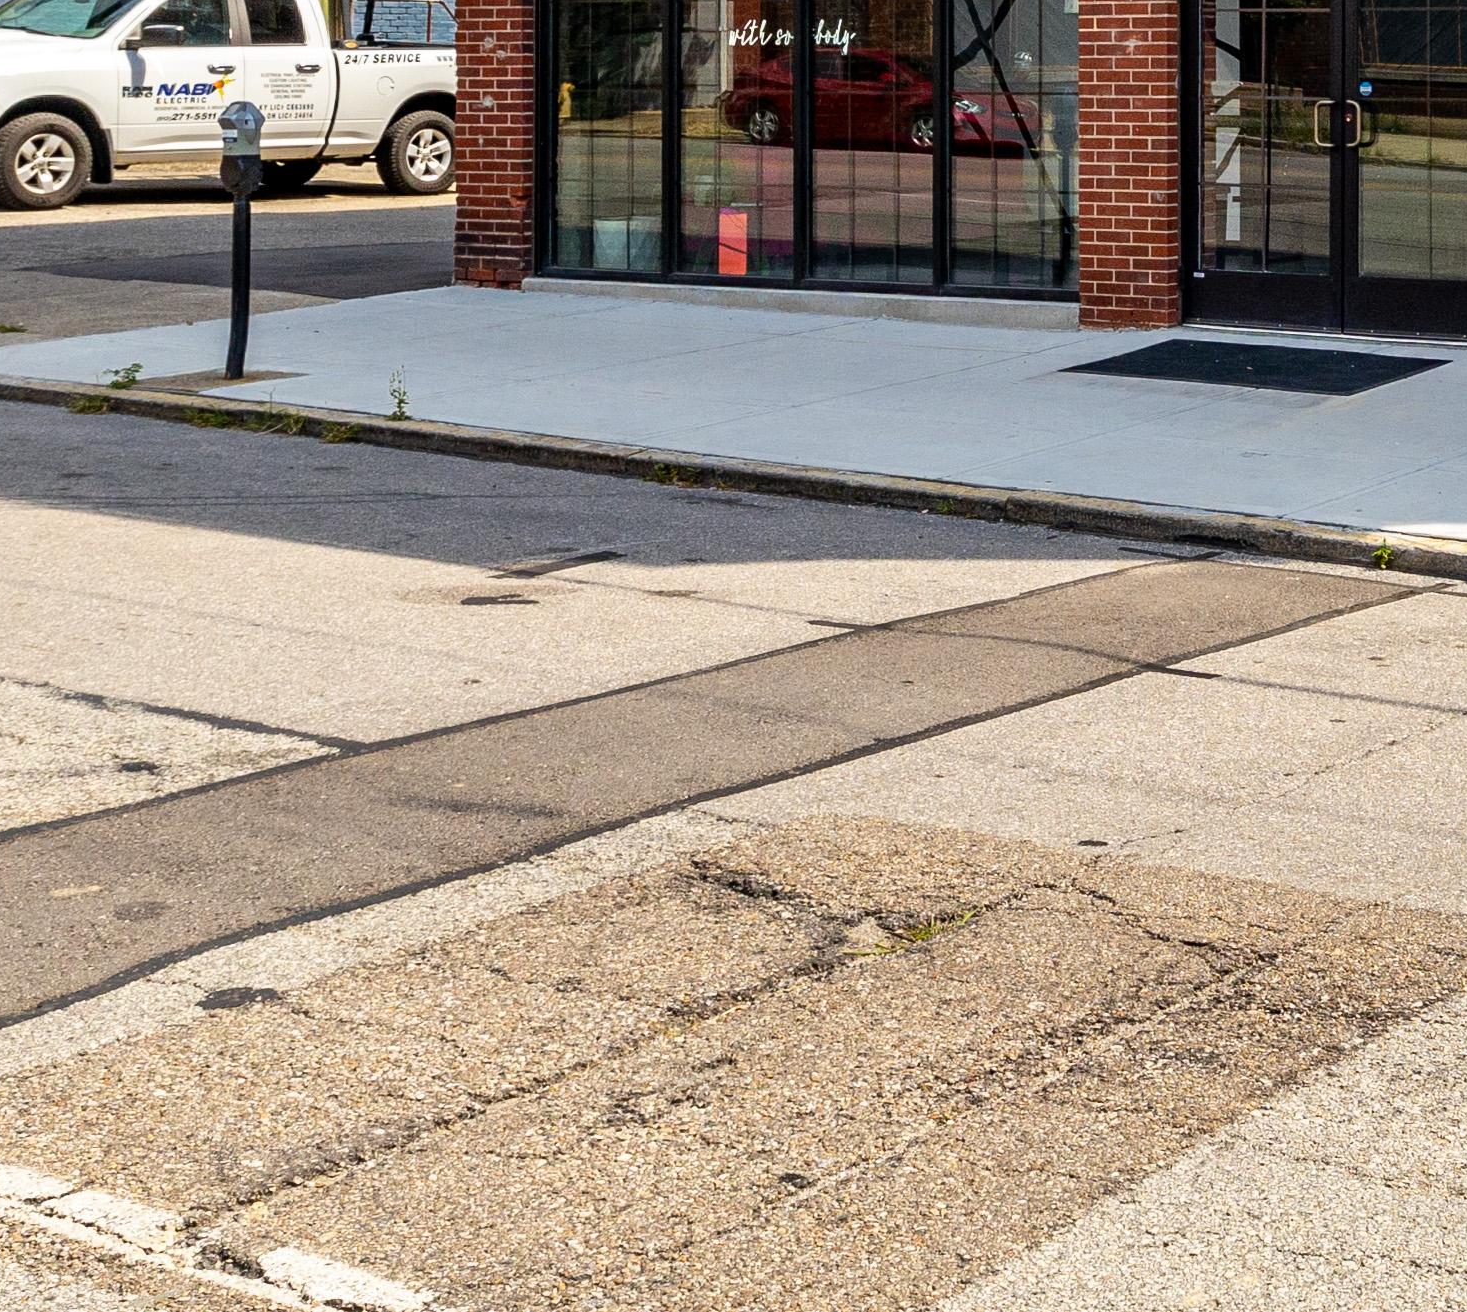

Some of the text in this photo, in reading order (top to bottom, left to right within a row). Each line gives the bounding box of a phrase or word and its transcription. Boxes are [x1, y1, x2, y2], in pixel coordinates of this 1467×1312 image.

[728, 18, 857, 56] with sobody
[344, 53, 422, 65] 24/7 SERVICE
[156, 96, 207, 105] ELECTRIC
